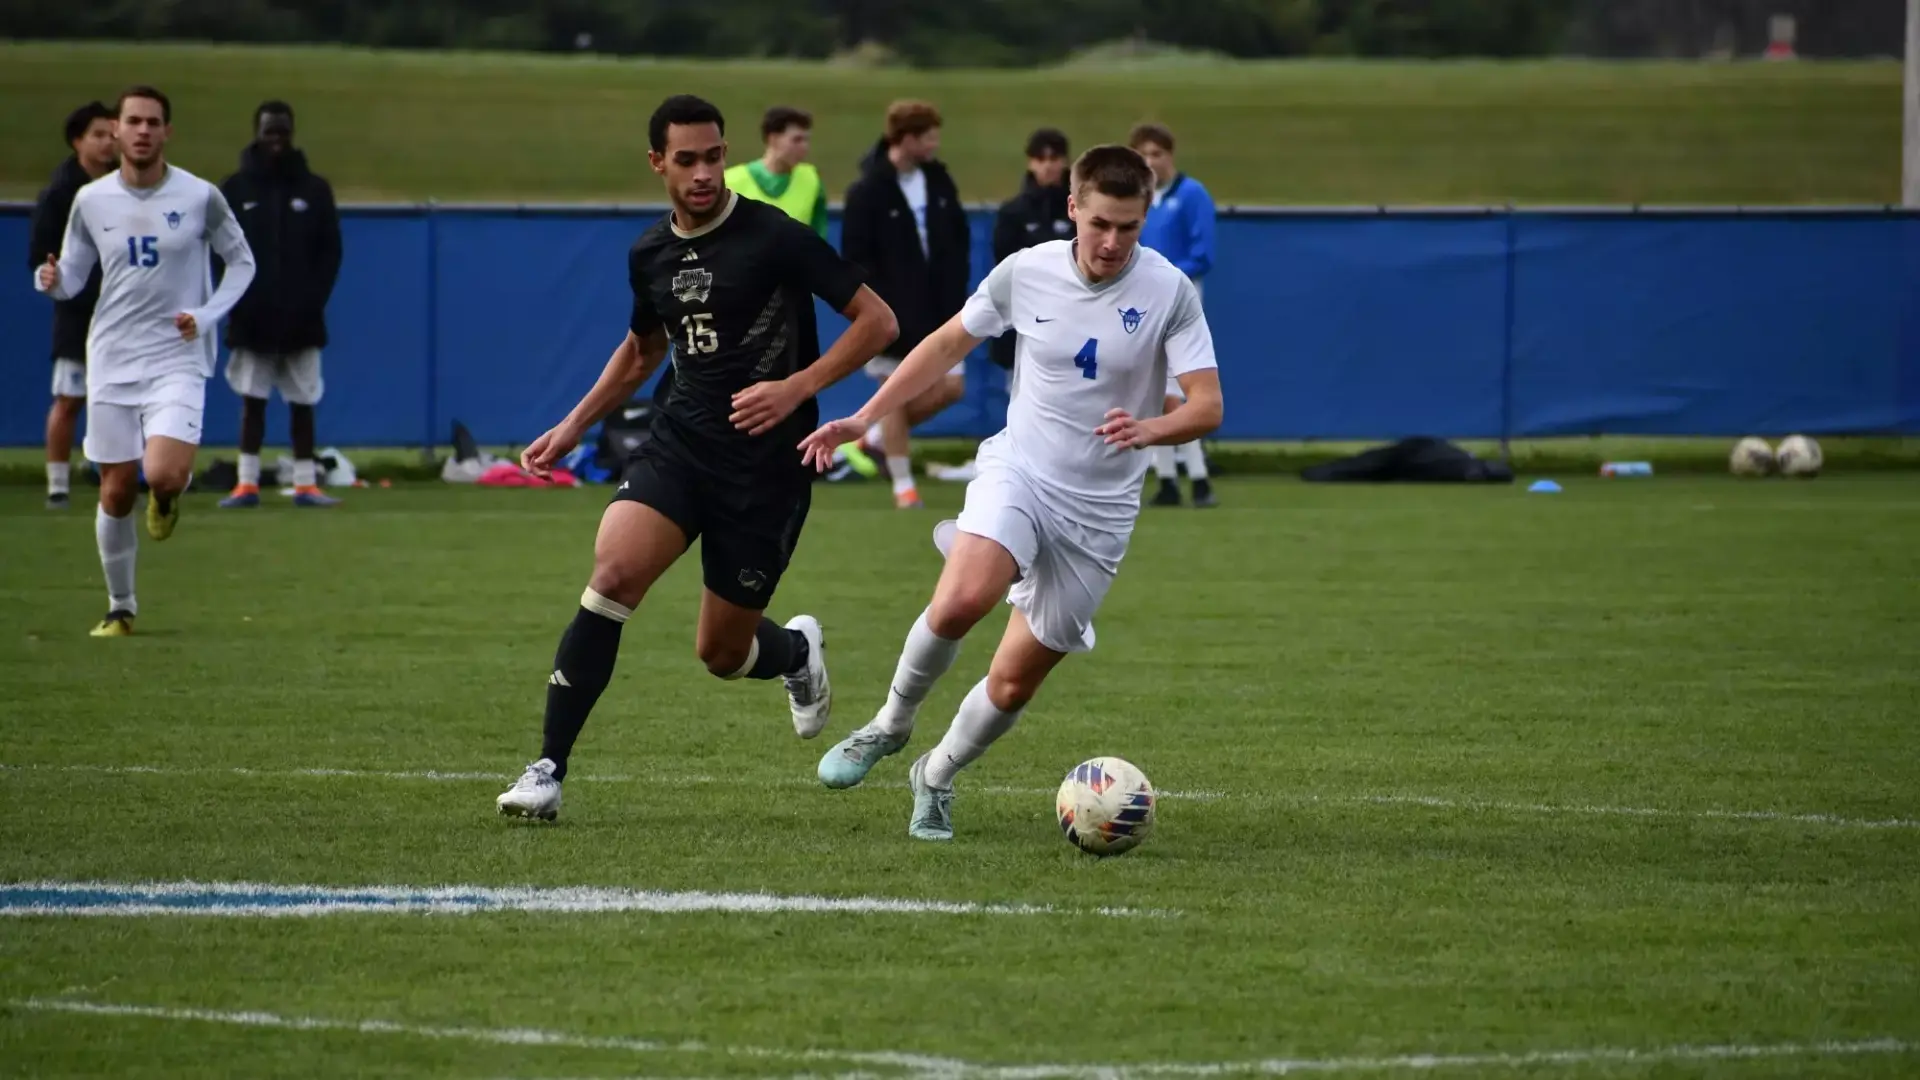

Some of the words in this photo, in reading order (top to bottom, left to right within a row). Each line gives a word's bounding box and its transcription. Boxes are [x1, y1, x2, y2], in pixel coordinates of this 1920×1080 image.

[127, 236, 159, 267] 15
[681, 313, 718, 354] 15
[1074, 338, 1098, 380] 4
